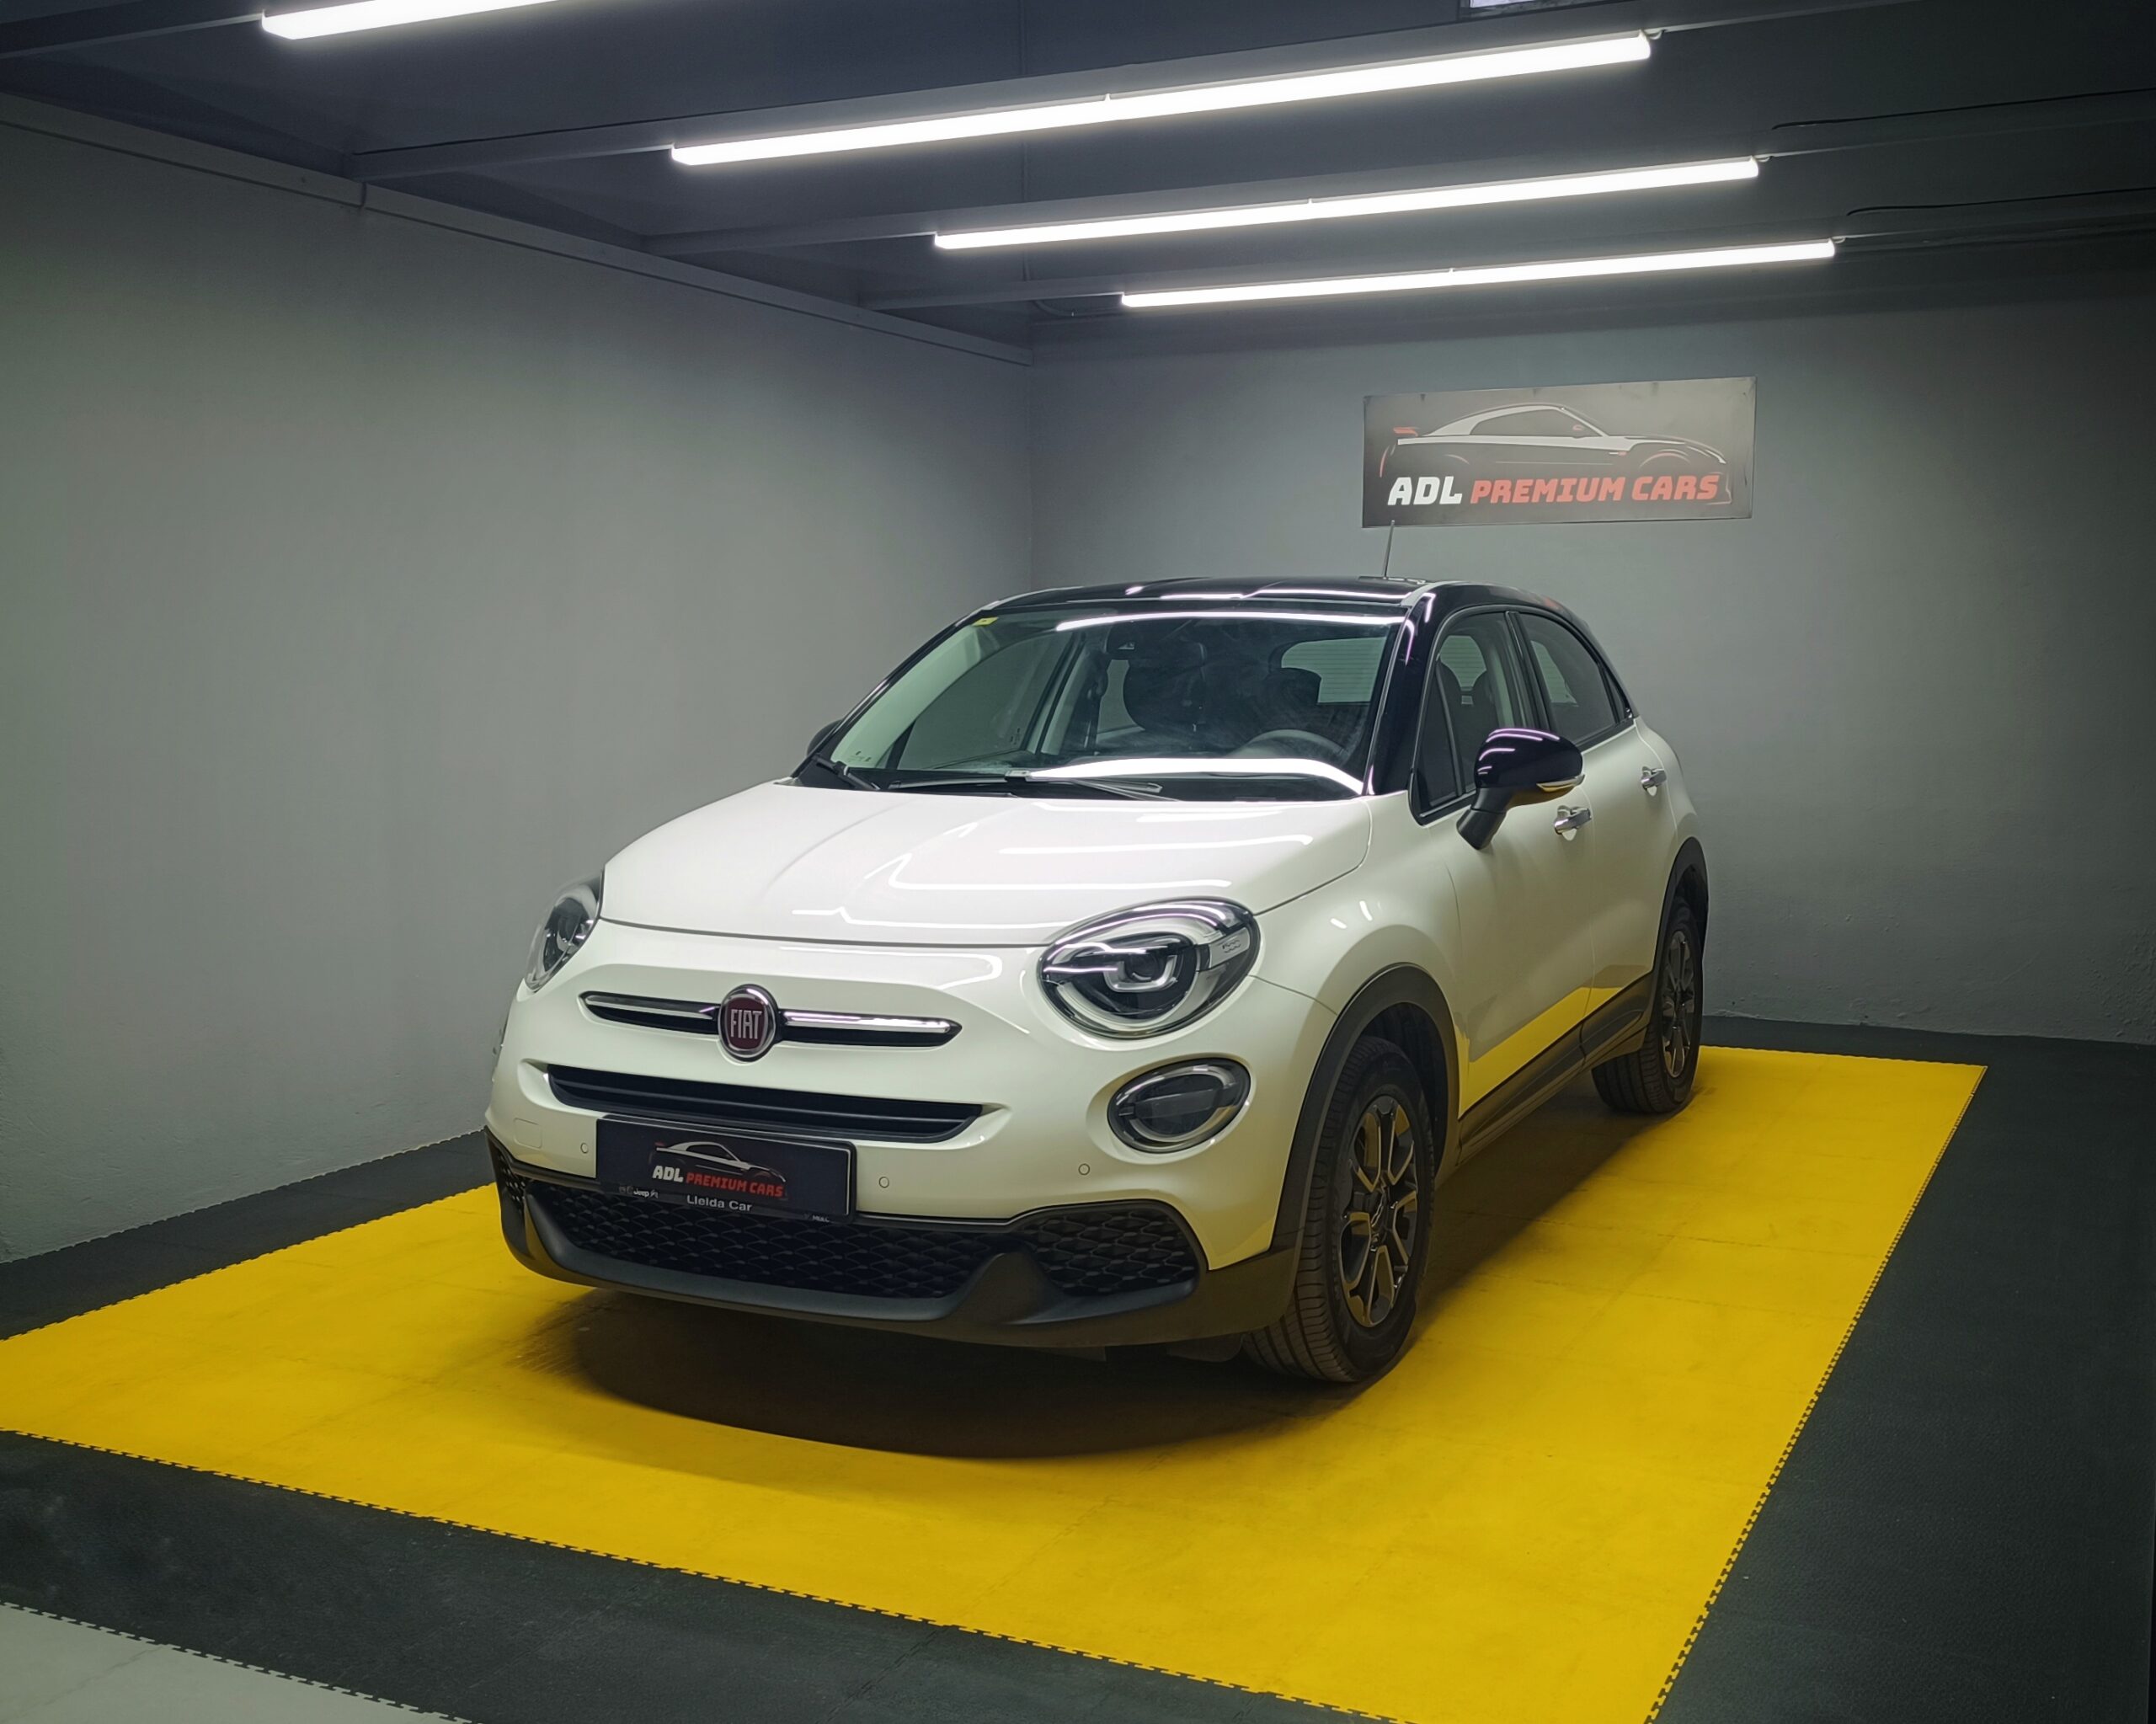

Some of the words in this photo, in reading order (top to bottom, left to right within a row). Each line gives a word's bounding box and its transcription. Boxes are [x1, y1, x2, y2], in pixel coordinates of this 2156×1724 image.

[1387, 475, 1463, 506] ADL
[1469, 476, 1626, 504] PREMIUM
[1631, 475, 1720, 501] CARS
[730, 1009, 763, 1039] FIAT
[652, 1165, 684, 1182] ADL
[686, 1172, 748, 1192] PREMIUM
[749, 1182, 784, 1198] CARS
[728, 1200, 753, 1212] Car
